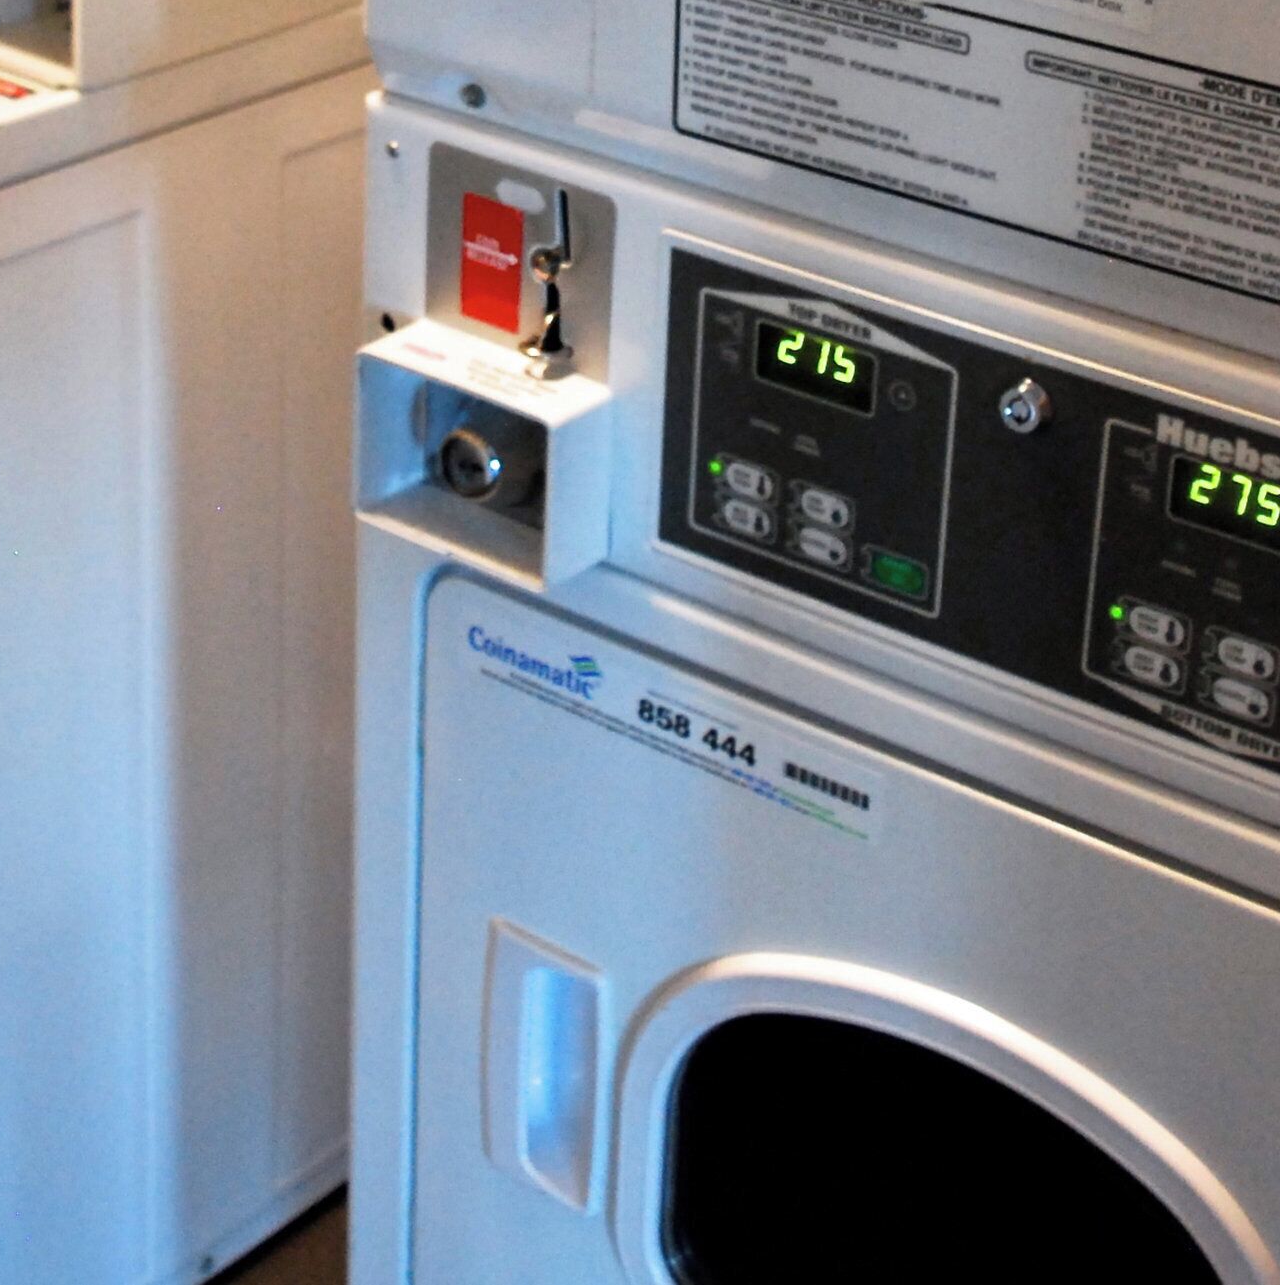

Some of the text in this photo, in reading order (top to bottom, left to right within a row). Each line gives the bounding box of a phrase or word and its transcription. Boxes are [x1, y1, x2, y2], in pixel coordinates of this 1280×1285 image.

[467, 625, 596, 700] Coinamatic
[638, 697, 691, 740] 858
[701, 727, 757, 767] 444
